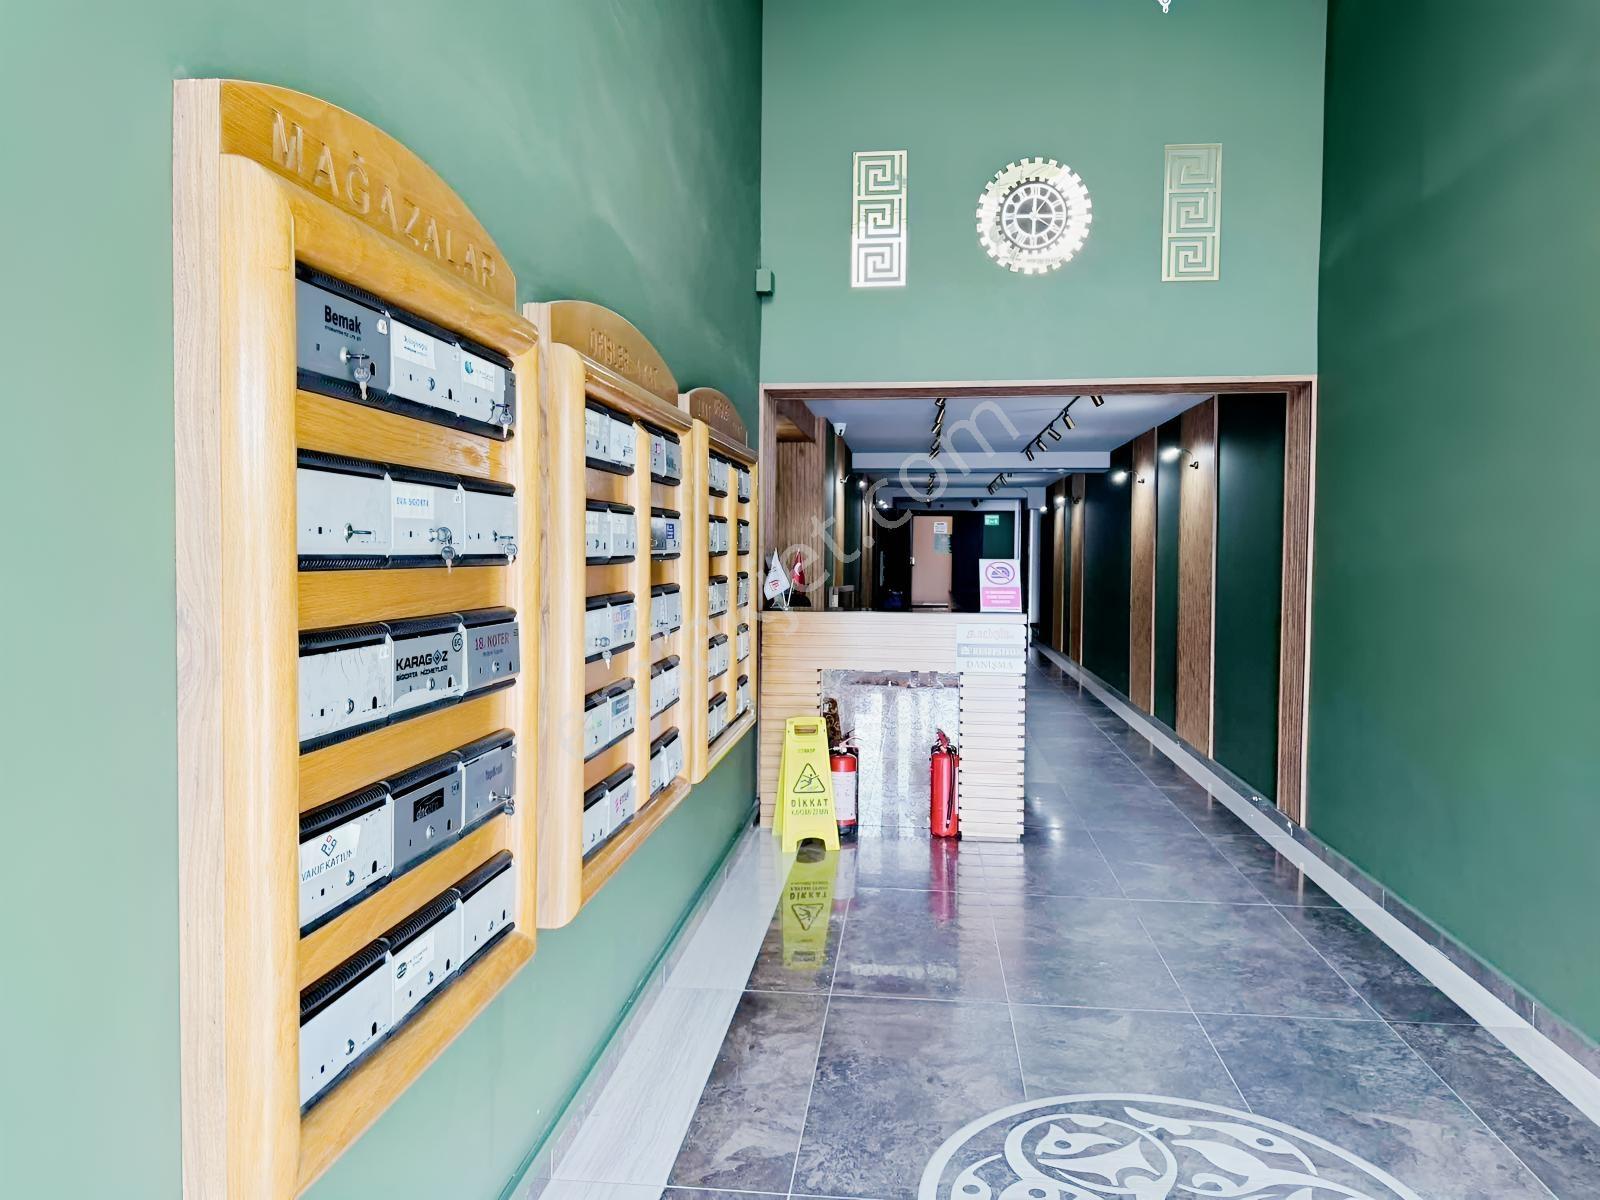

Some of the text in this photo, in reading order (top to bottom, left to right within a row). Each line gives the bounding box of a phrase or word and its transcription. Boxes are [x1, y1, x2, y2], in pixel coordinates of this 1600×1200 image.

[271, 107, 497, 288] MAĞAZALAR
[325, 304, 361, 335] Bemak
[791, 796, 828, 808] DİKKAT
